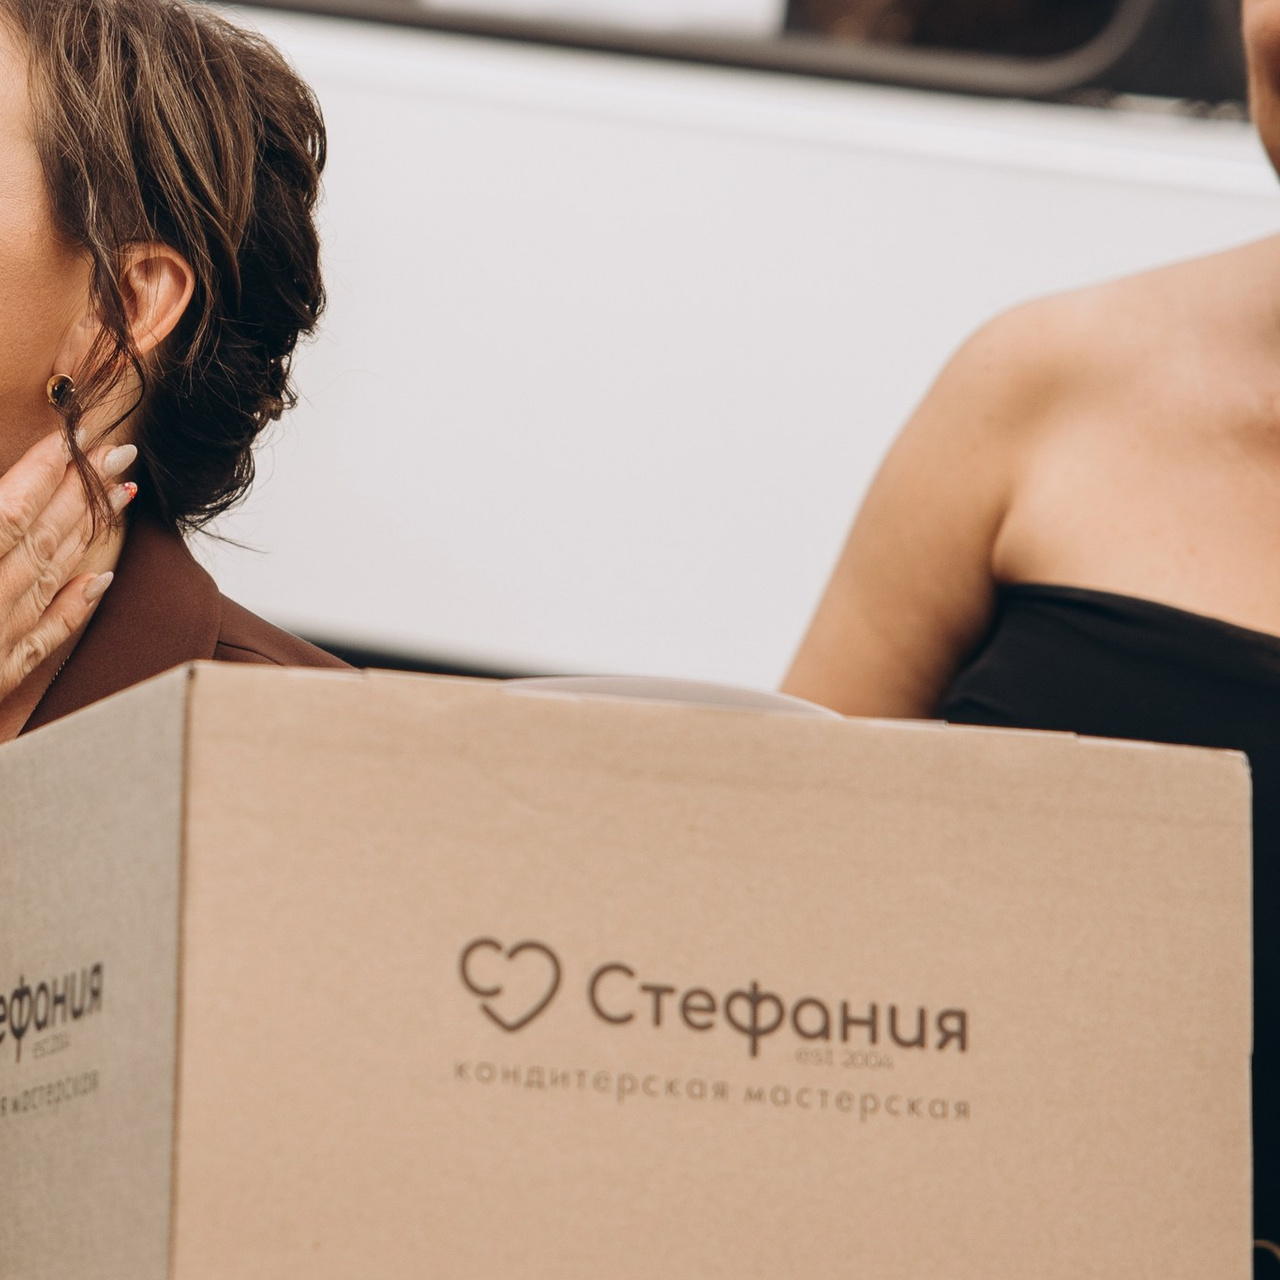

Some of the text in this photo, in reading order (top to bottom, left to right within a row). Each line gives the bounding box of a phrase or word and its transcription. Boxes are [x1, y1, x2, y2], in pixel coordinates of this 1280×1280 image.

[588, 961, 969, 1058] Стефания
[453, 1059, 971, 1121] кондитерская мастерская
